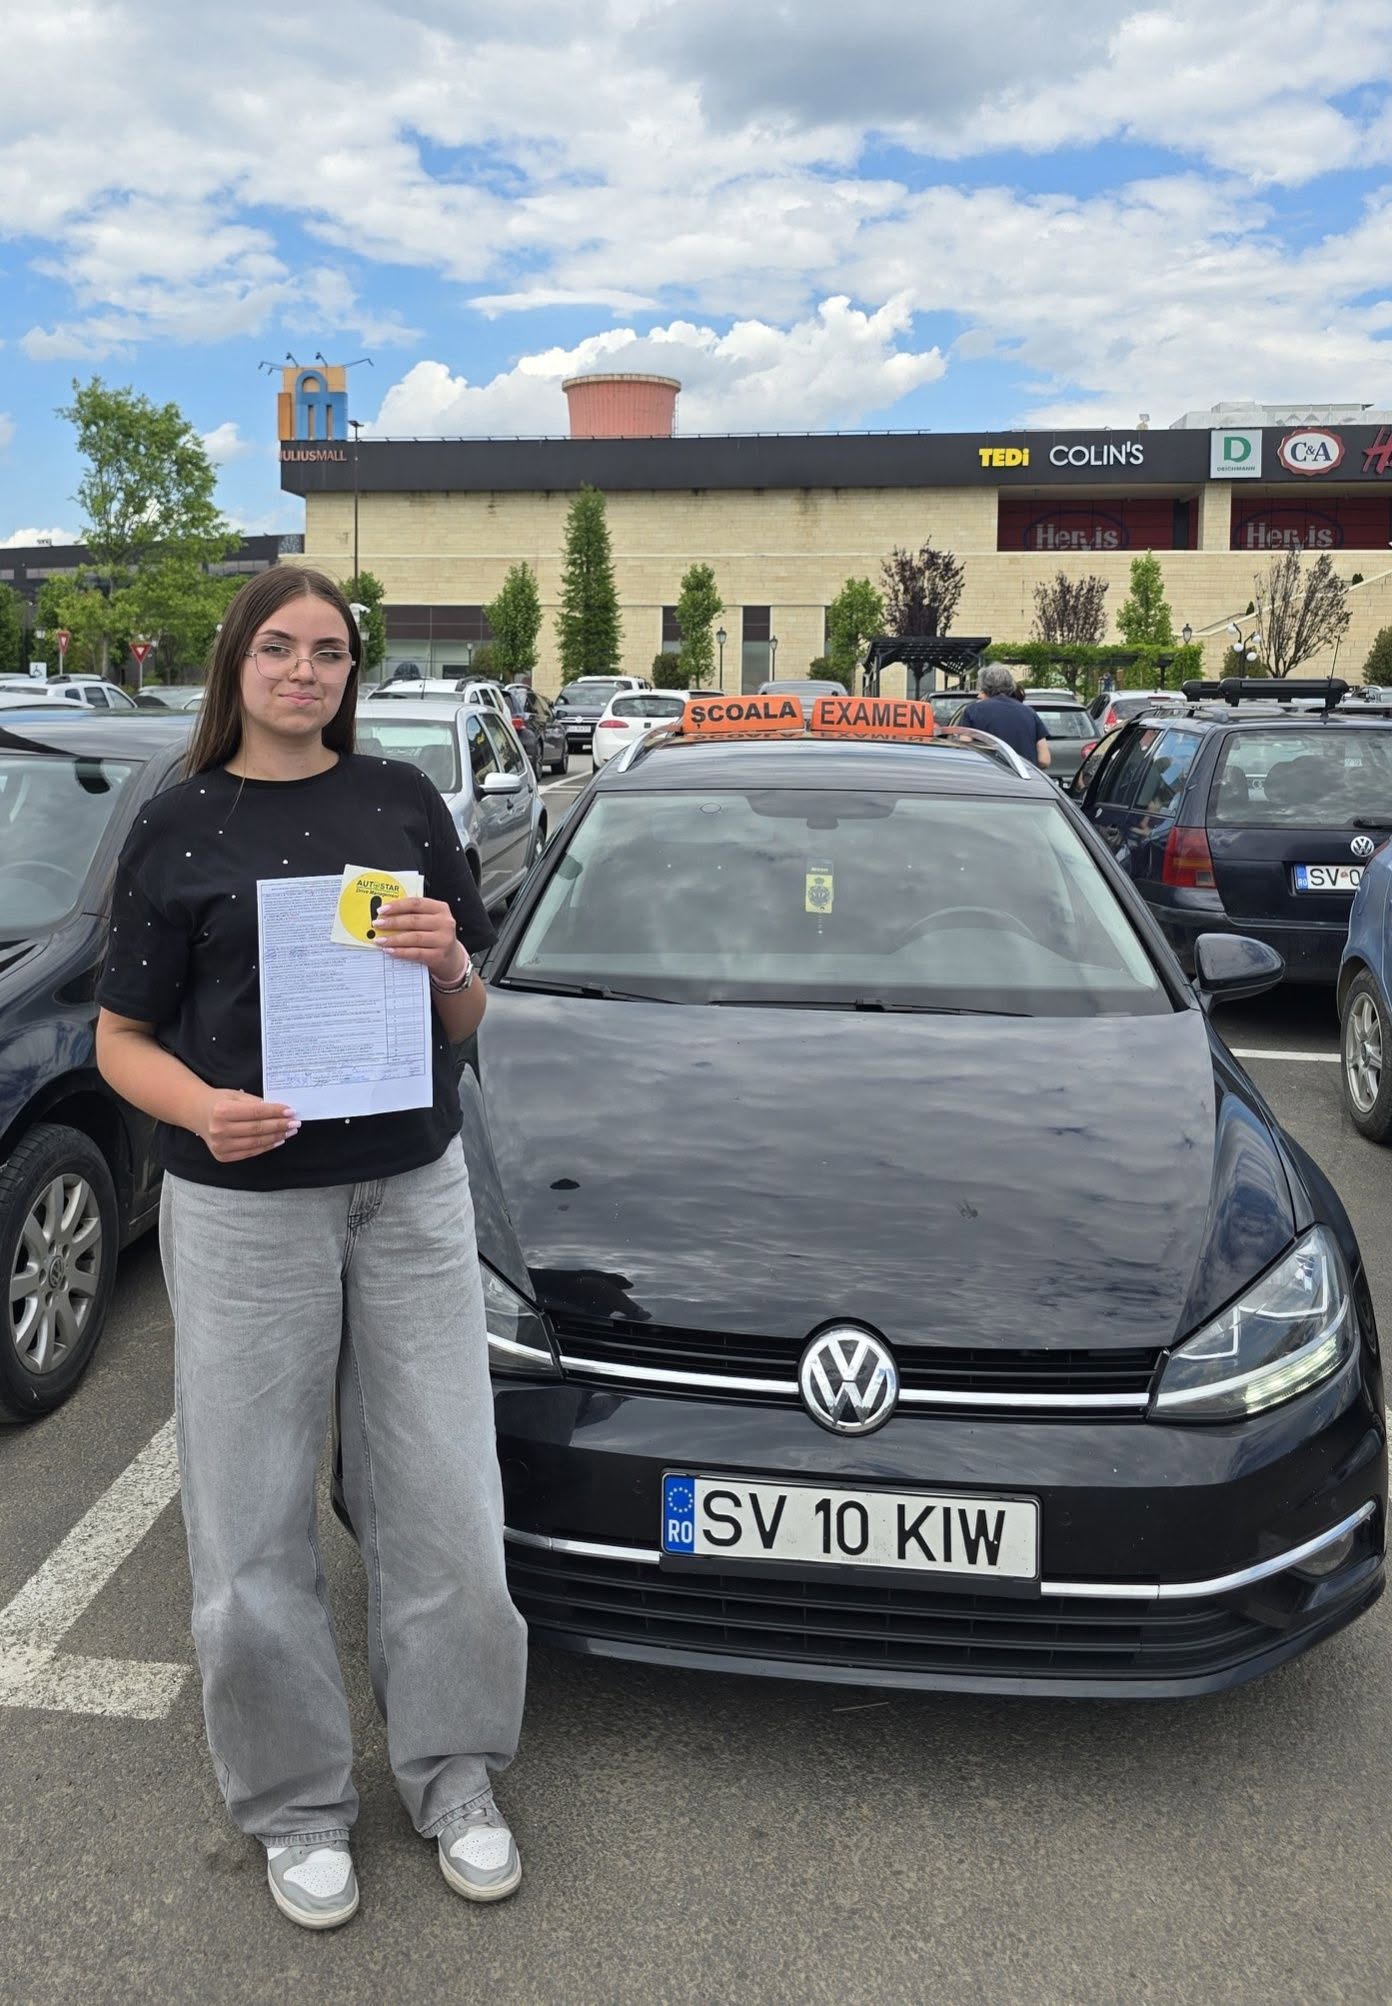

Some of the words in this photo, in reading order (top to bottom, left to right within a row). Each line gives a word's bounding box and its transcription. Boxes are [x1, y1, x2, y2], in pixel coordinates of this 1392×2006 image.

[979, 448, 1030, 467] TEDi
[1049, 441, 1144, 466] COLIN'S
[1223, 436, 1252, 463] D
[1290, 441, 1333, 463] C&A
[820, 701, 926, 729] EXAMEN
[1309, 868, 1339, 886] SV
[668, 1519, 692, 1544] RO
[702, 1489, 787, 1549] SV
[815, 1498, 869, 1556] 10
[897, 1503, 1006, 1566] KIW
